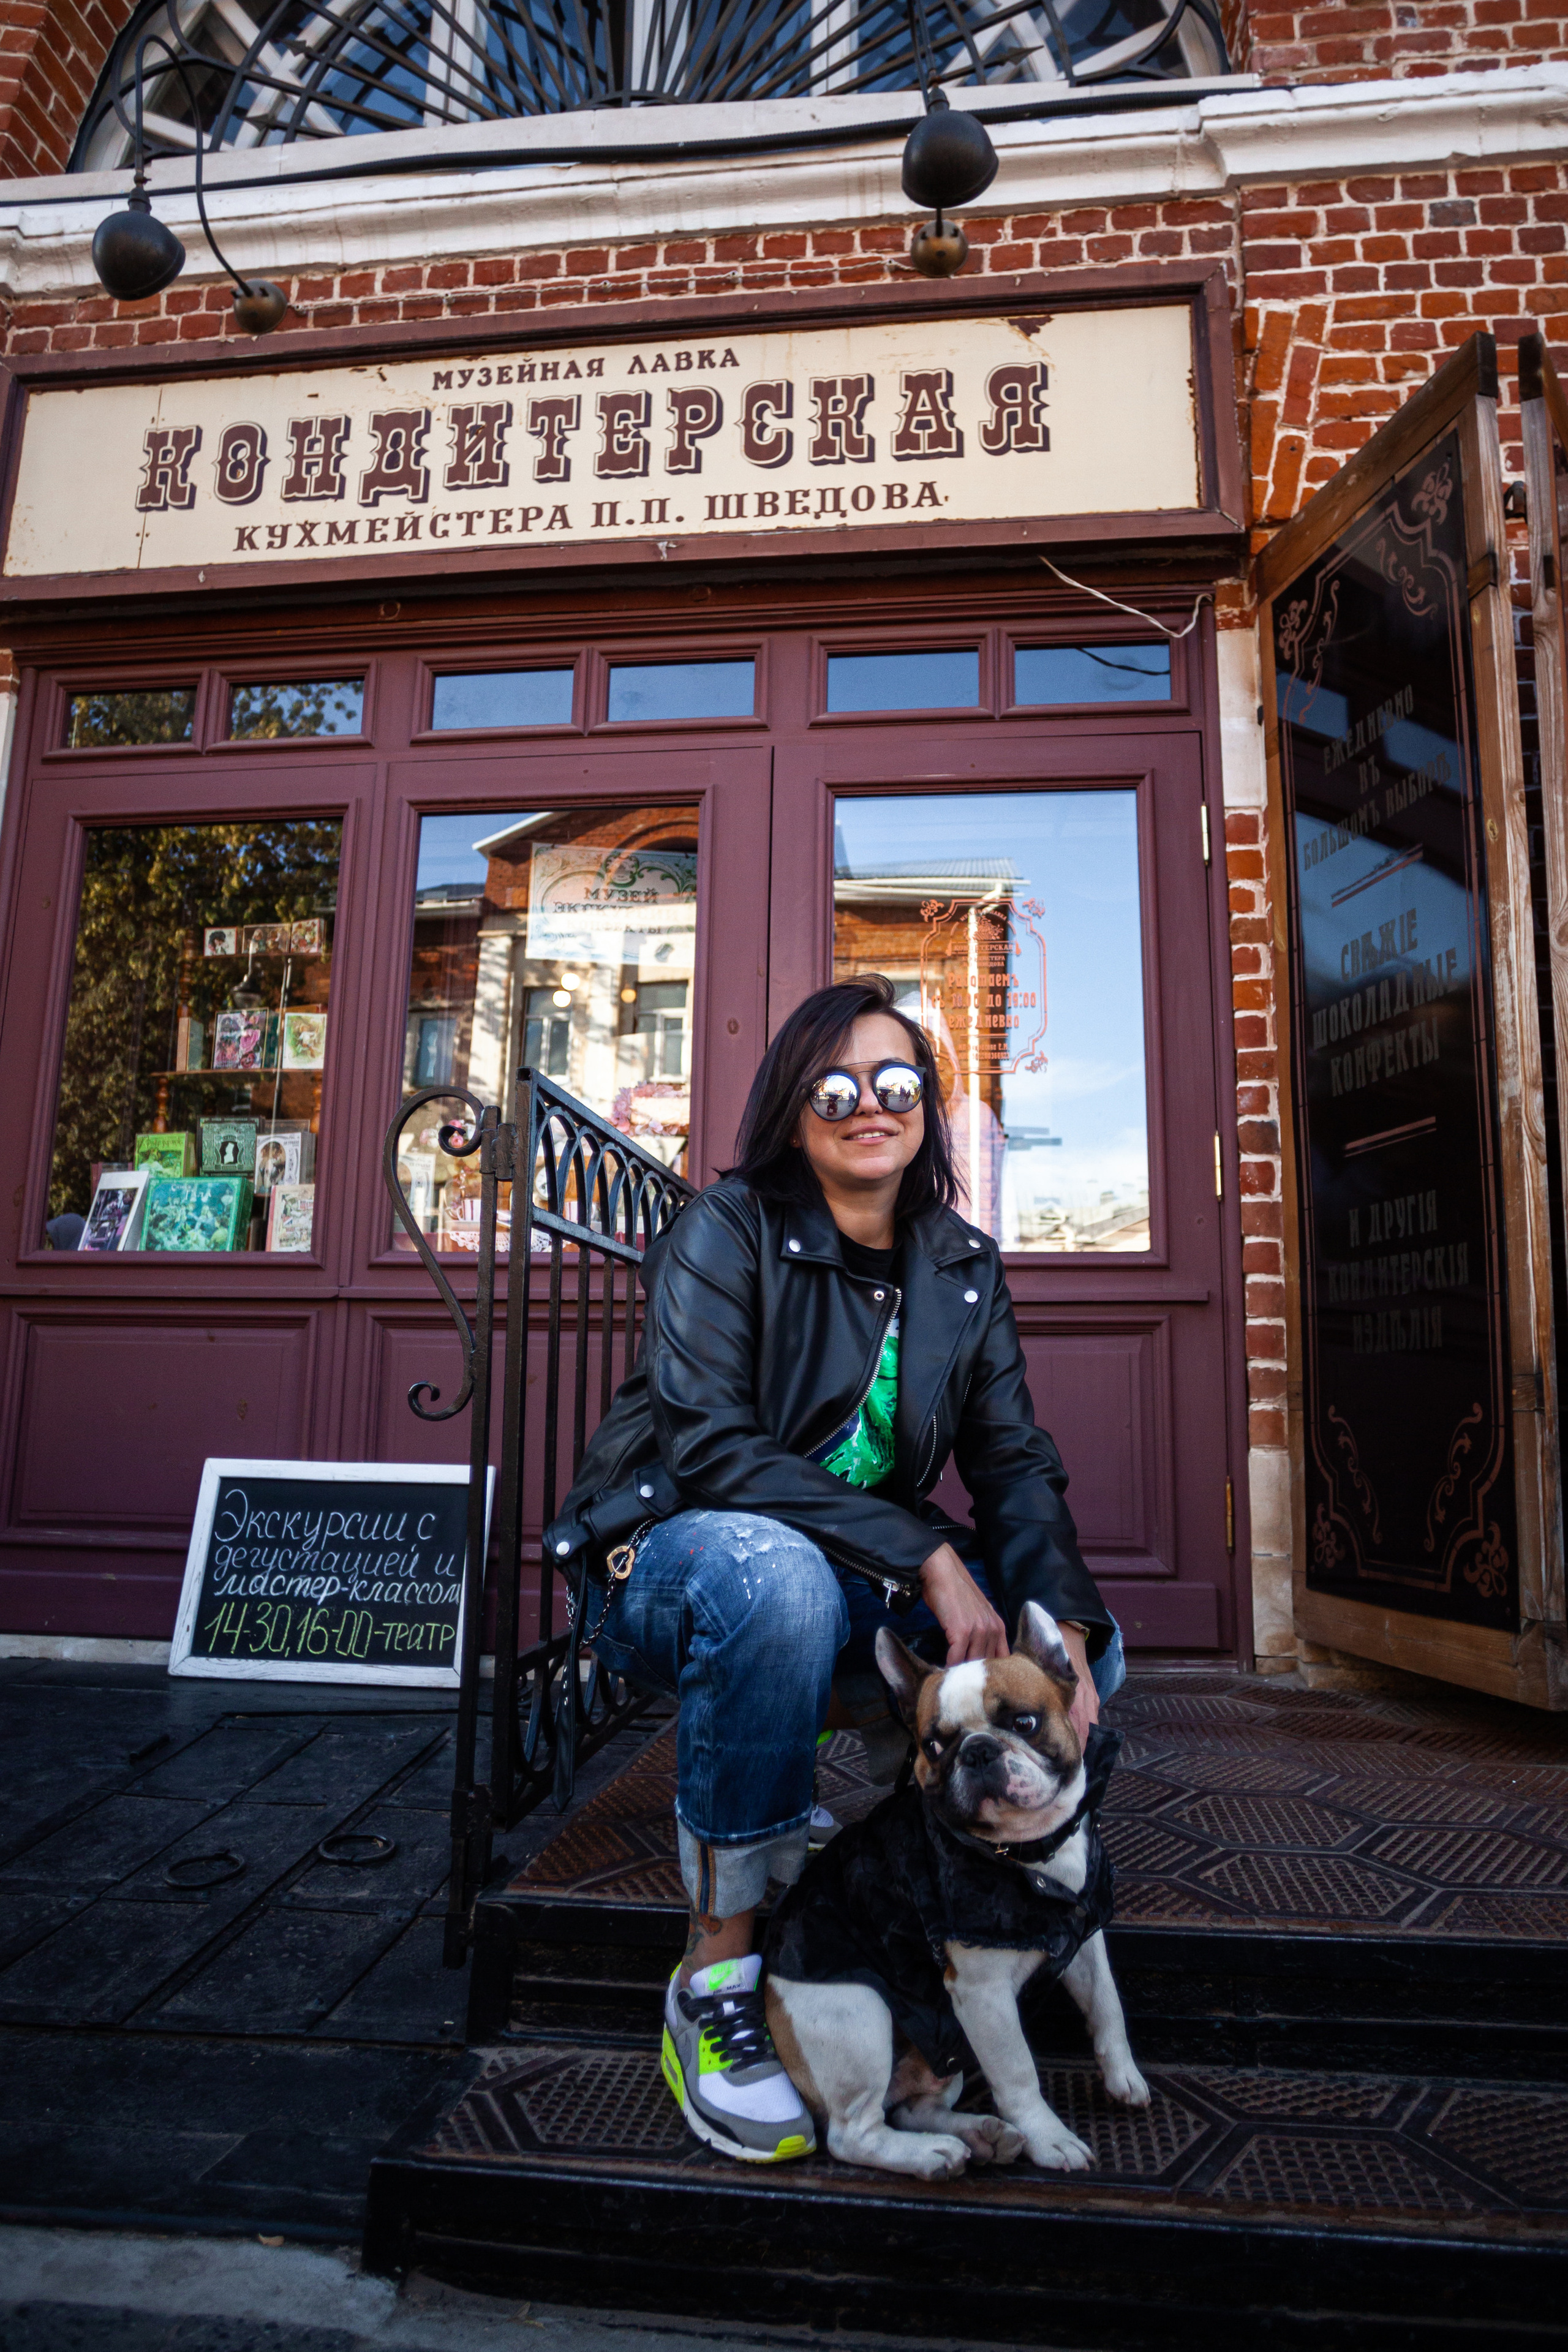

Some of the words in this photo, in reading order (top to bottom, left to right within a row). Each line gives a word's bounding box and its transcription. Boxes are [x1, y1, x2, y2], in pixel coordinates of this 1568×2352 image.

[431, 356, 604, 391] МУЗЕЙНАЯ
[627, 347, 740, 375] ЛАВКА
[135, 361, 1050, 511] КОНДИТЕРСКАЯ
[233, 501, 573, 552] КУХМЕЙСТЕРА
[590, 497, 685, 527] П.П.
[704, 480, 943, 521] ШВЕДОВА
[1324, 684, 1414, 775] ЕЖЕДНЕВНО
[1303, 799, 1380, 871] БОЛЬШОМЪ
[583, 887, 659, 903] МУЗЕЙ
[986, 993, 1002, 1008] до
[1007, 992, 1036, 1008] 19:00
[1313, 947, 1458, 1050] ШОКОЛАДНЫЕ
[1331, 1017, 1439, 1097] КОНФЕКТЫ
[1349, 1208, 1360, 1248] И
[214, 1489, 408, 1551] Экскурсии
[417, 1513, 436, 1540] с
[214, 1543, 418, 1583] дегустацией
[434, 1553, 455, 1577] и
[214, 1574, 461, 1606] мастер-классом
